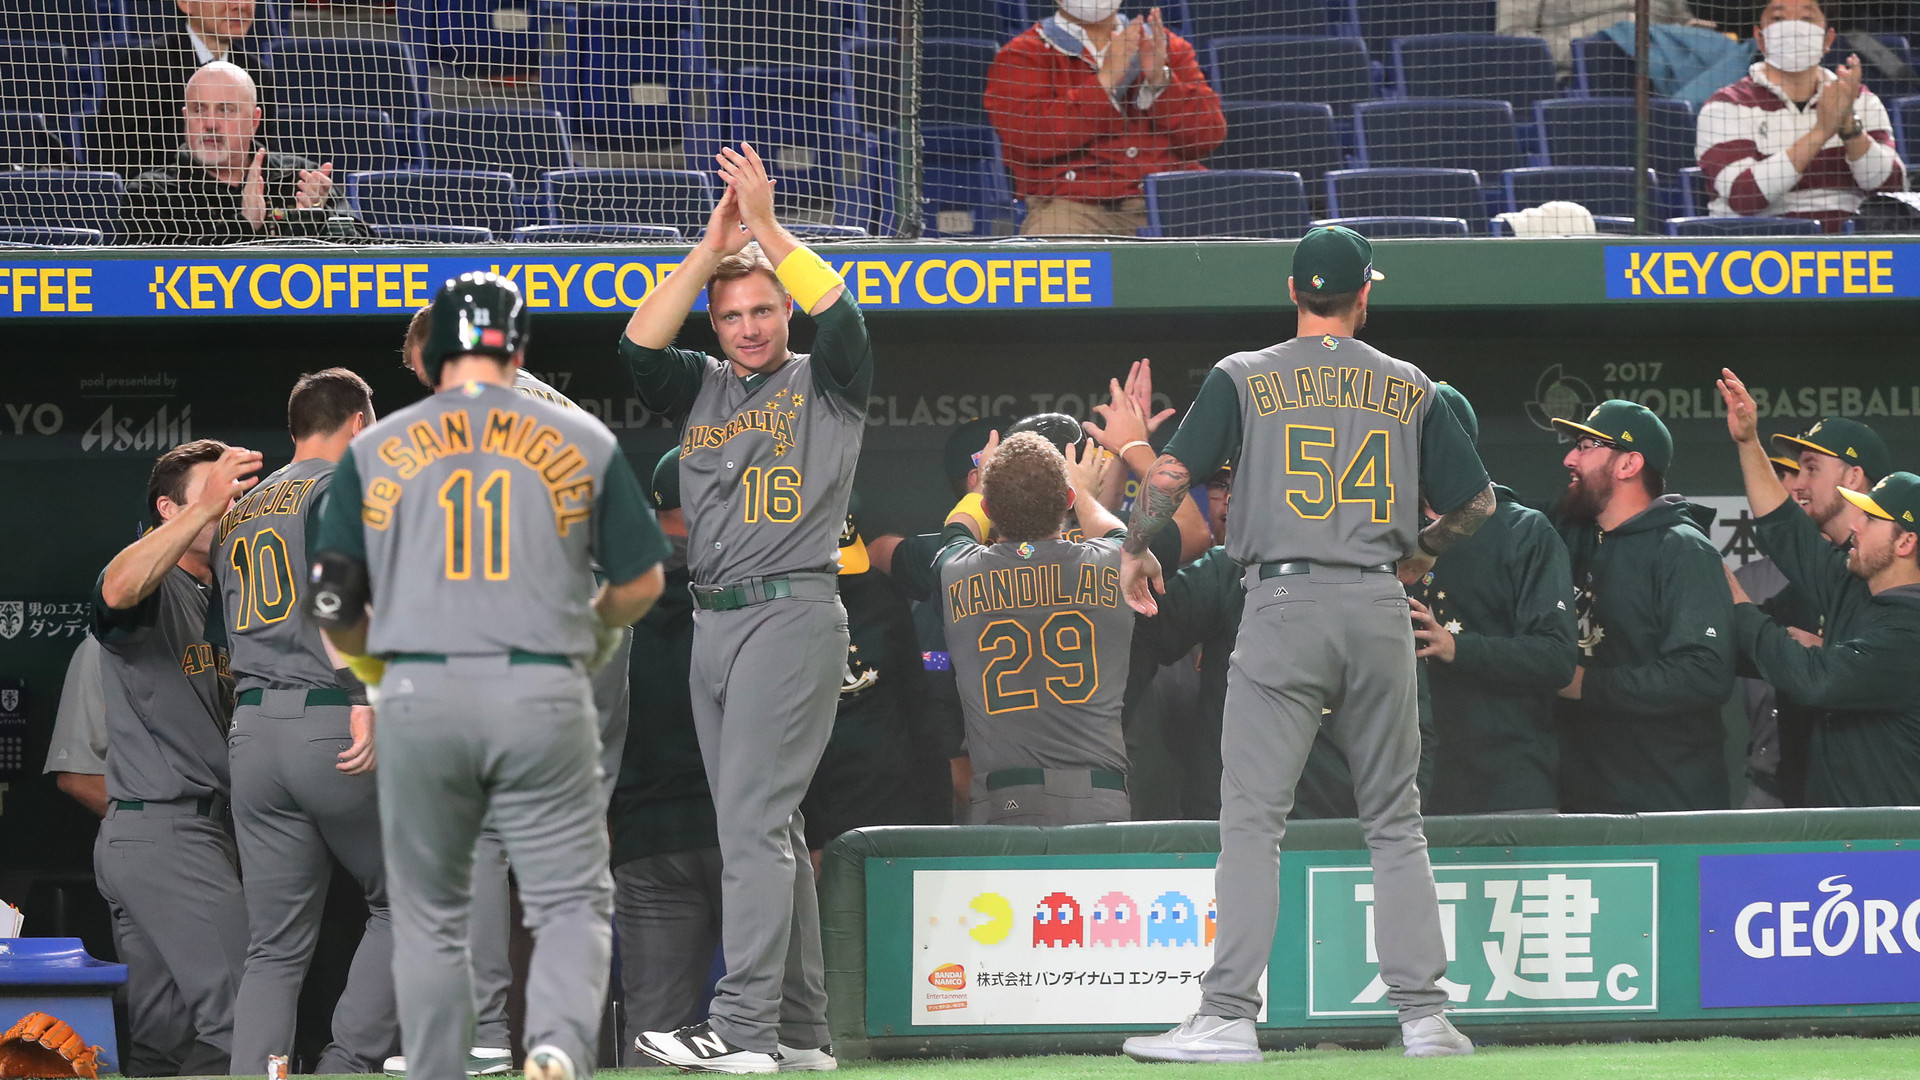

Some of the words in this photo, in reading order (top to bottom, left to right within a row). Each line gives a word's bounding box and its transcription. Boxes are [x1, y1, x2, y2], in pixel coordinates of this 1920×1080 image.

[80, 373, 104, 389] pool
[106, 372, 162, 388] presented
[163, 372, 178, 389] by
[1247, 366, 1425, 425] BLACKLEY
[1603, 362, 1663, 383] 2017
[81, 403, 192, 452] Asahi
[679, 410, 795, 460] AUSRALIA
[378, 409, 474, 480] SAN
[481, 408, 594, 537] MIGUEL
[742, 466, 802, 523] 16
[1285, 424, 1395, 523] 54
[438, 469, 511, 580] 11
[231, 527, 296, 630] 10
[948, 563, 1120, 623] KANDILAS
[978, 610, 1099, 715] 29
[926, 992, 968, 1000] Entertainment
[934, 971, 963, 979] BANDAI
[934, 978, 963, 986] NAMCO
